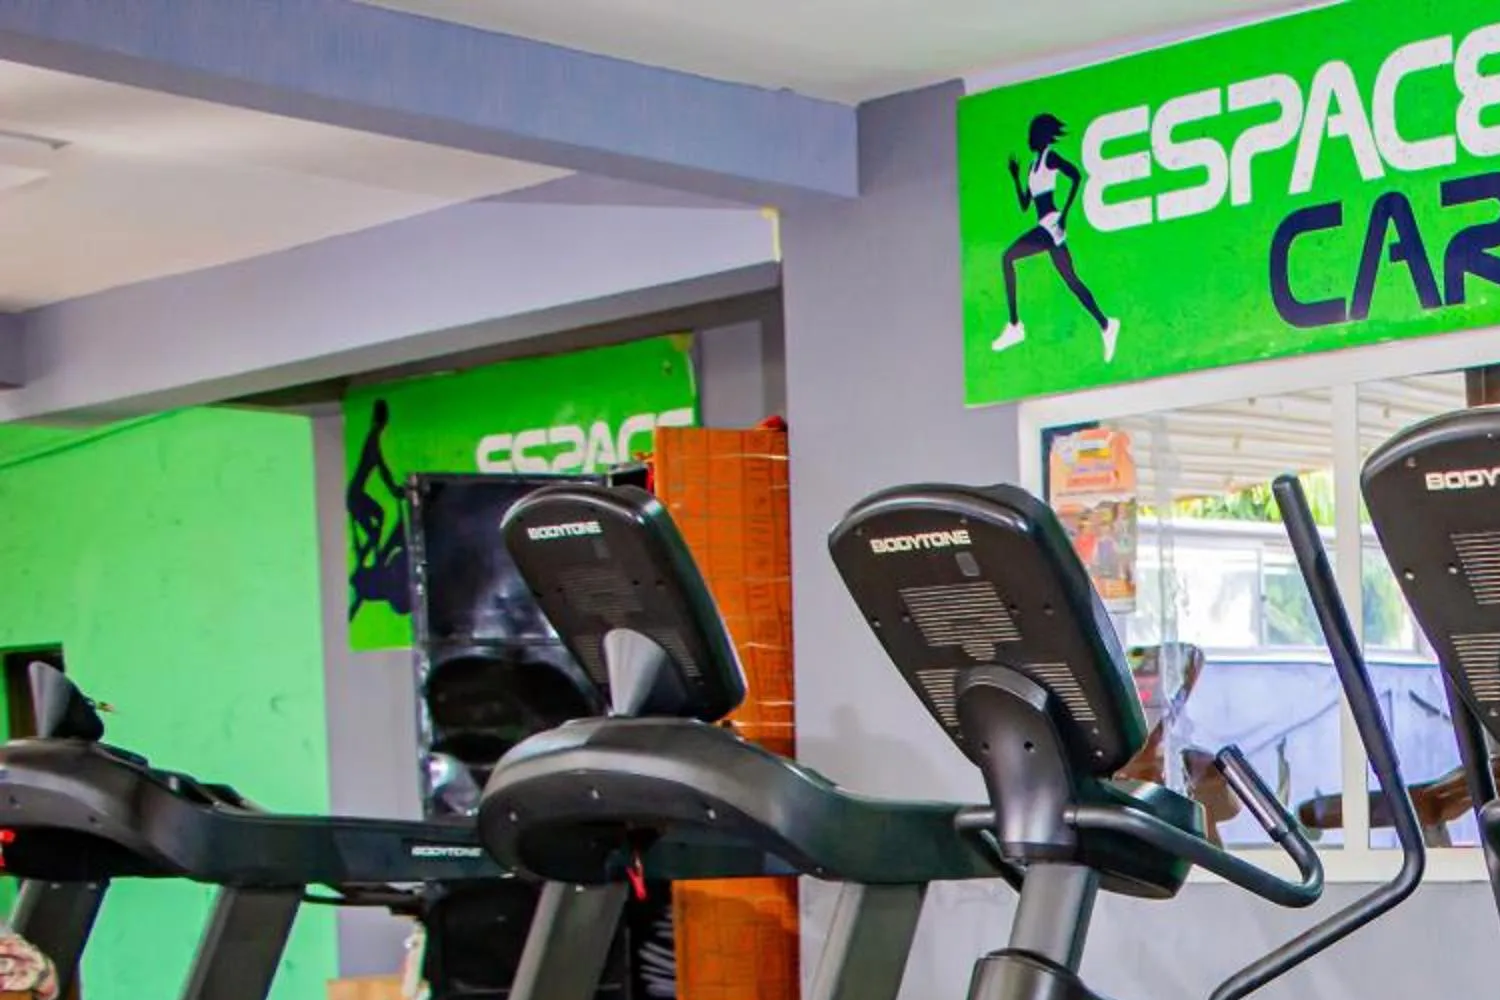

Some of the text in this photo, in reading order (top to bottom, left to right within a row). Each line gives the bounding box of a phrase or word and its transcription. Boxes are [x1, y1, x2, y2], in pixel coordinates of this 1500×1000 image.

[476, 408, 694, 474] ESPAC
[527, 521, 602, 541] BODYTONE
[869, 529, 972, 554] BODYTONE
